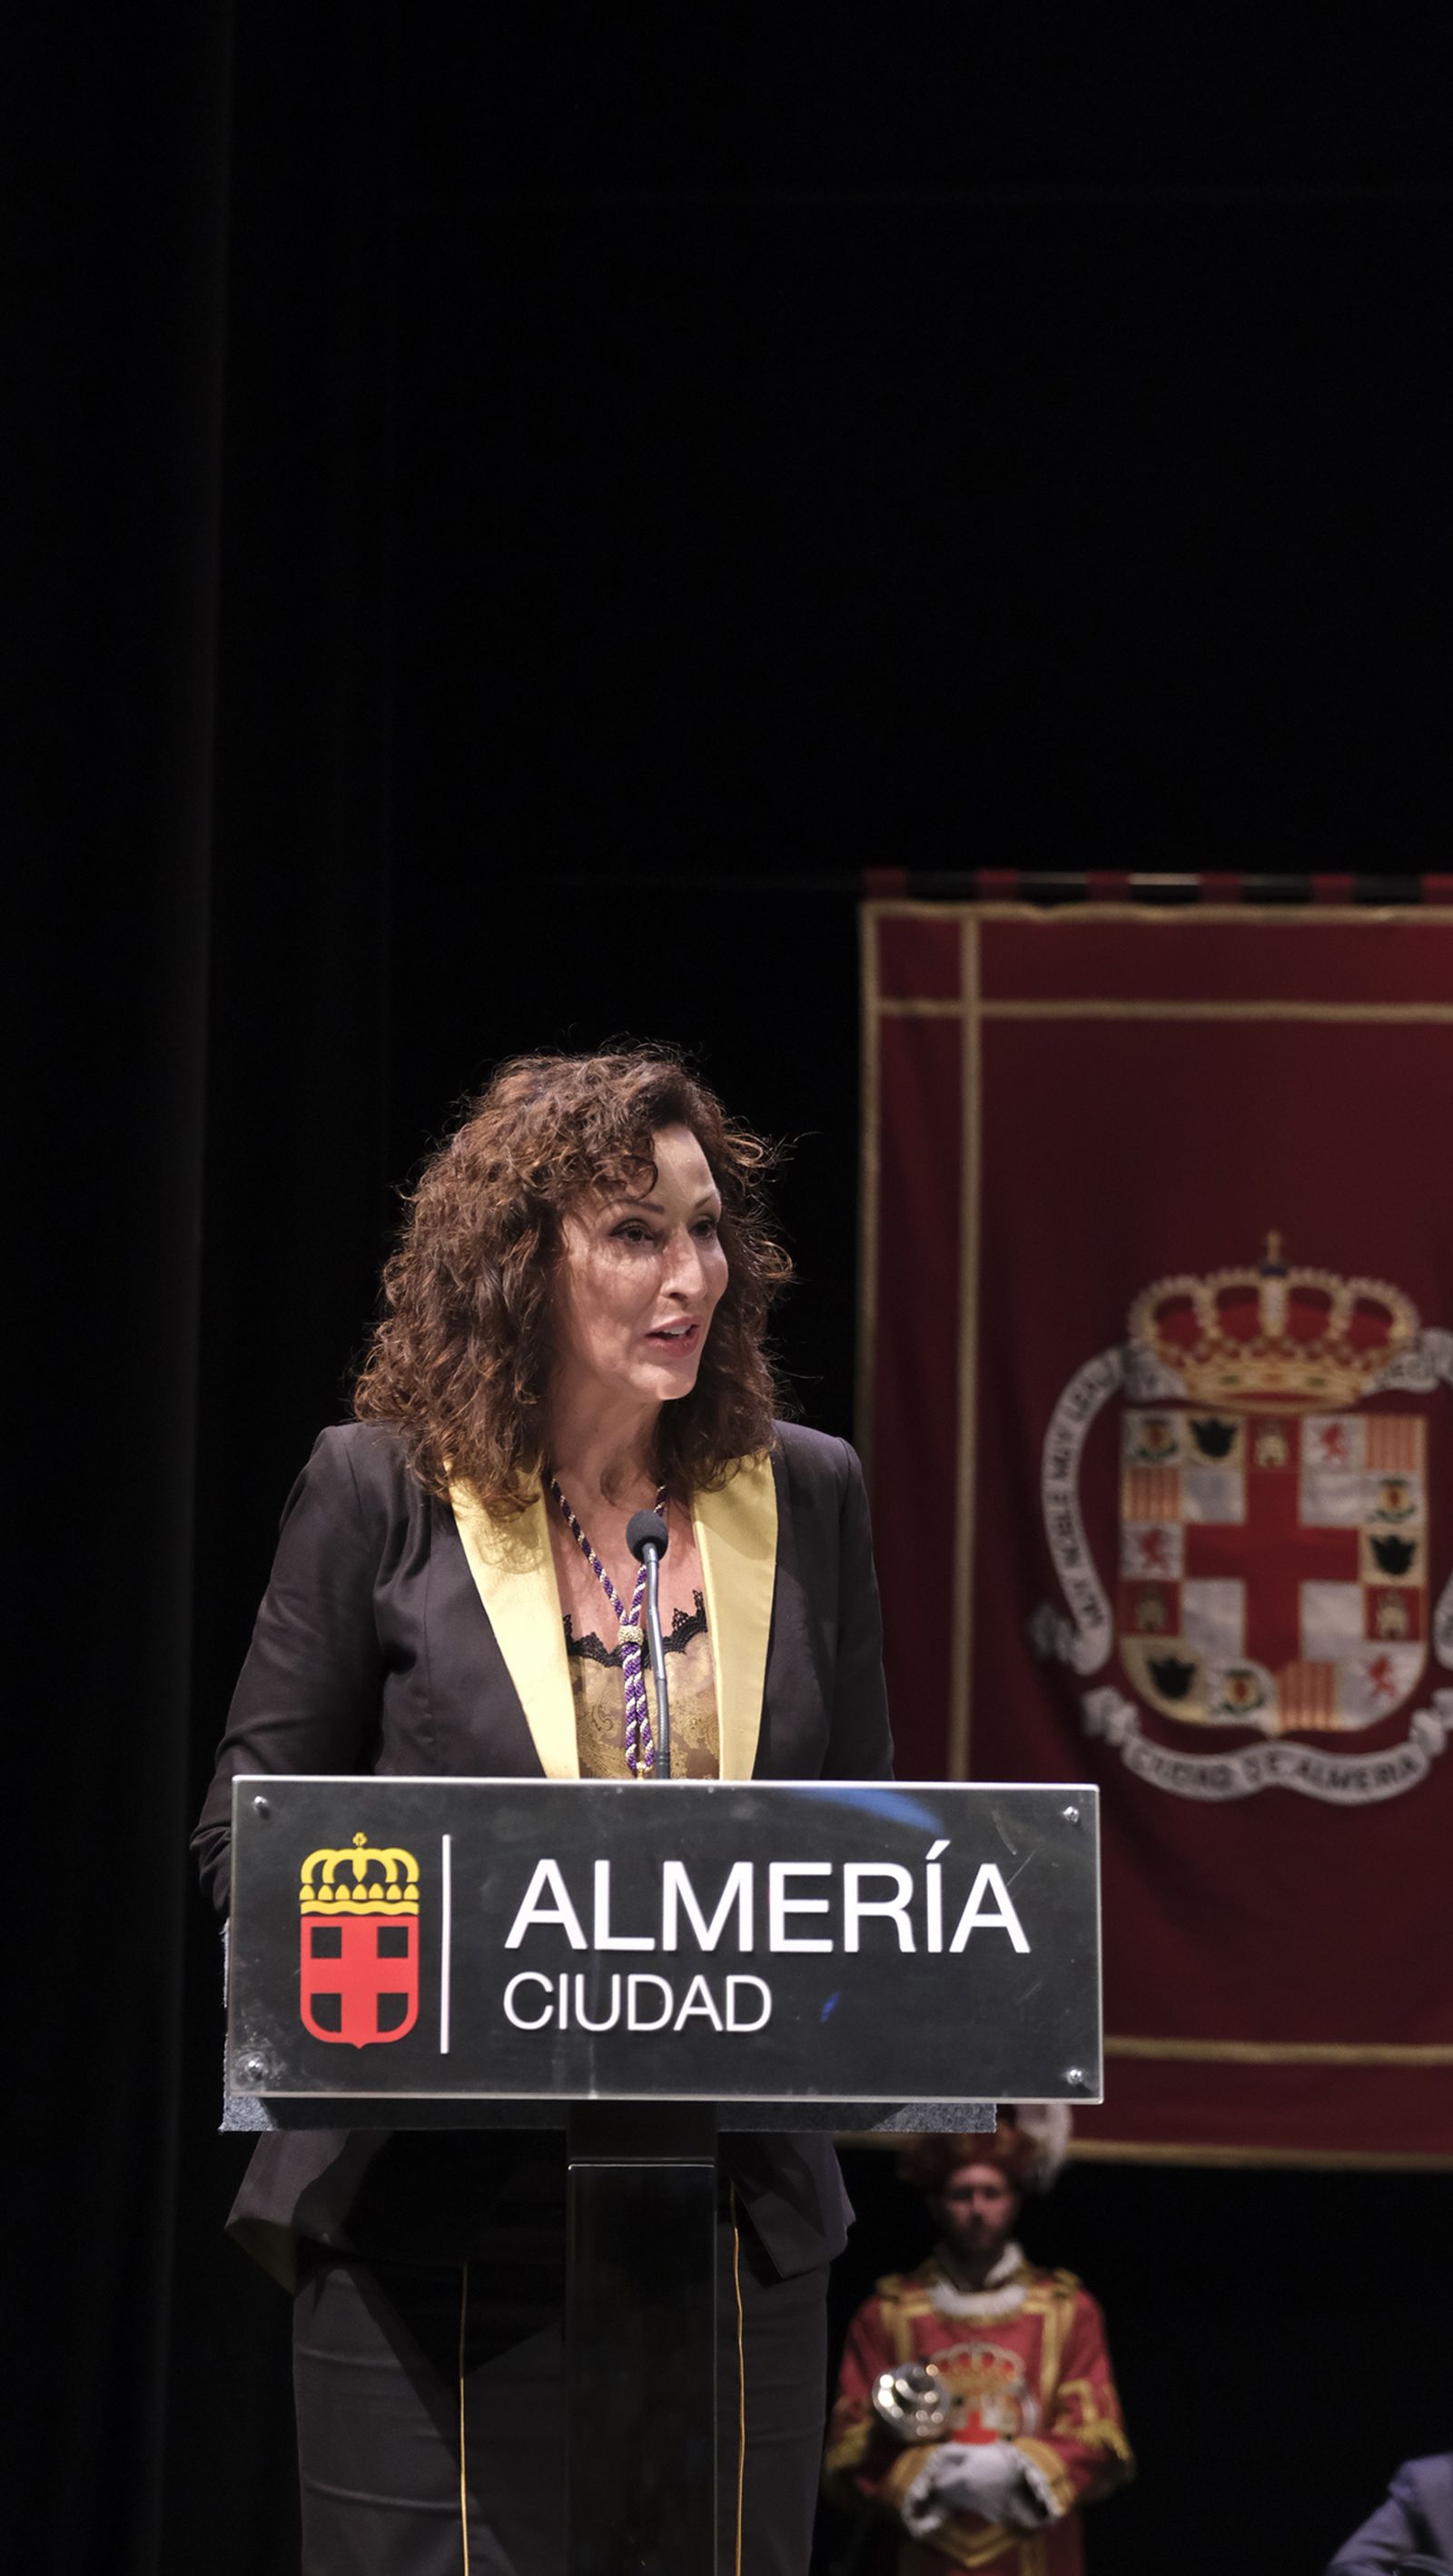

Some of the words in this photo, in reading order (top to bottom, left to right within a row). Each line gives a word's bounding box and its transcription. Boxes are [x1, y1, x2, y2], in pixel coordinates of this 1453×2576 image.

[1132, 1745, 1234, 1790] CIUDAD
[505, 1840, 1031, 1953] ALMERÍA
[503, 1971, 772, 2032] CIUDAD
